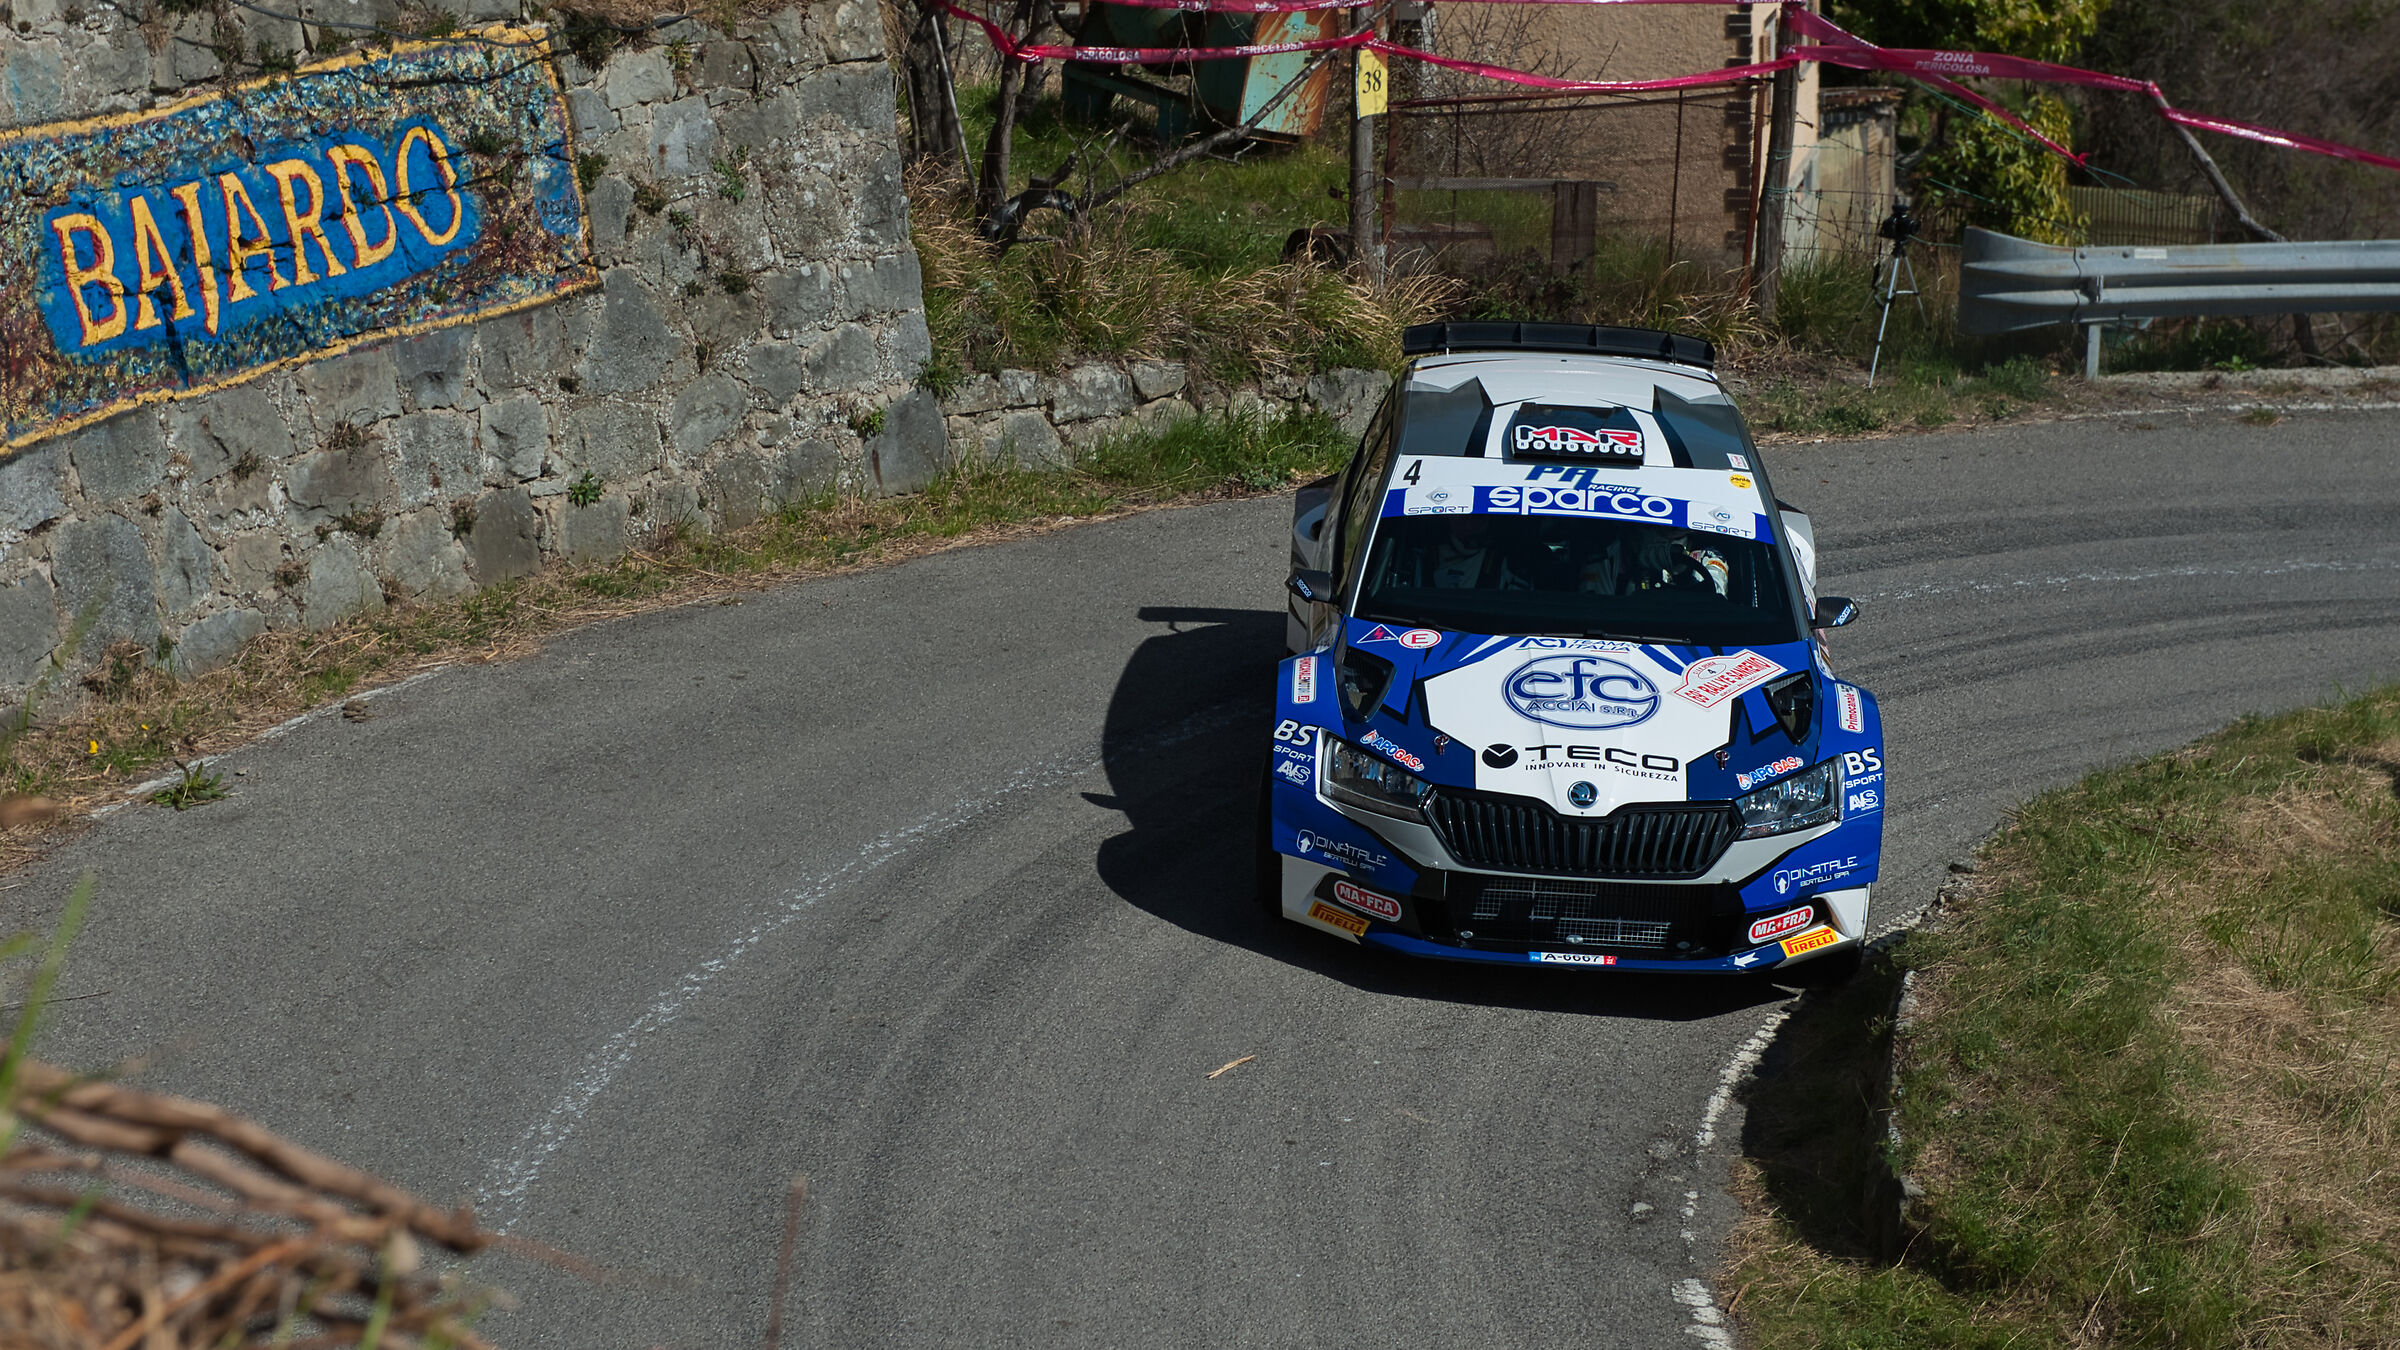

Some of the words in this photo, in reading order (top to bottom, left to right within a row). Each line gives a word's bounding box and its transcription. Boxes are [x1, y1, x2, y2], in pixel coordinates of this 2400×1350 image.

[1914, 60, 1990, 75] PERICOLOSA
[1933, 51, 1974, 64] ZONA
[1362, 69, 1382, 94] 38
[51, 125, 463, 348] BAJARDO
[1516, 440, 1643, 456] ROBOTICA
[1403, 460, 1423, 486] 4
[1588, 483, 1637, 494] RACING
[1407, 505, 1469, 515] SPORT
[1488, 486, 1674, 518] sparco
[1691, 521, 1752, 538] SPORT
[1411, 633, 1429, 645] E
[1697, 674, 1738, 697] RALLYE
[1725, 656, 1772, 681] SANREMO
[1526, 700, 1596, 713] ACCIAI
[1273, 719, 1318, 746] BS
[1273, 744, 1315, 762] SPORT
[1371, 736, 1421, 769] APOGAS
[1524, 744, 1680, 773] TECO
[1843, 748, 1882, 776] BS
[1524, 761, 1587, 772] INNOVARE
[1614, 766, 1678, 783] SICUREZZA
[1749, 756, 1798, 784] APOGAS
[1845, 773, 1883, 789] SPORT
[1312, 903, 1367, 934] PIRELLI
[1784, 928, 1836, 955] PIRELLI
